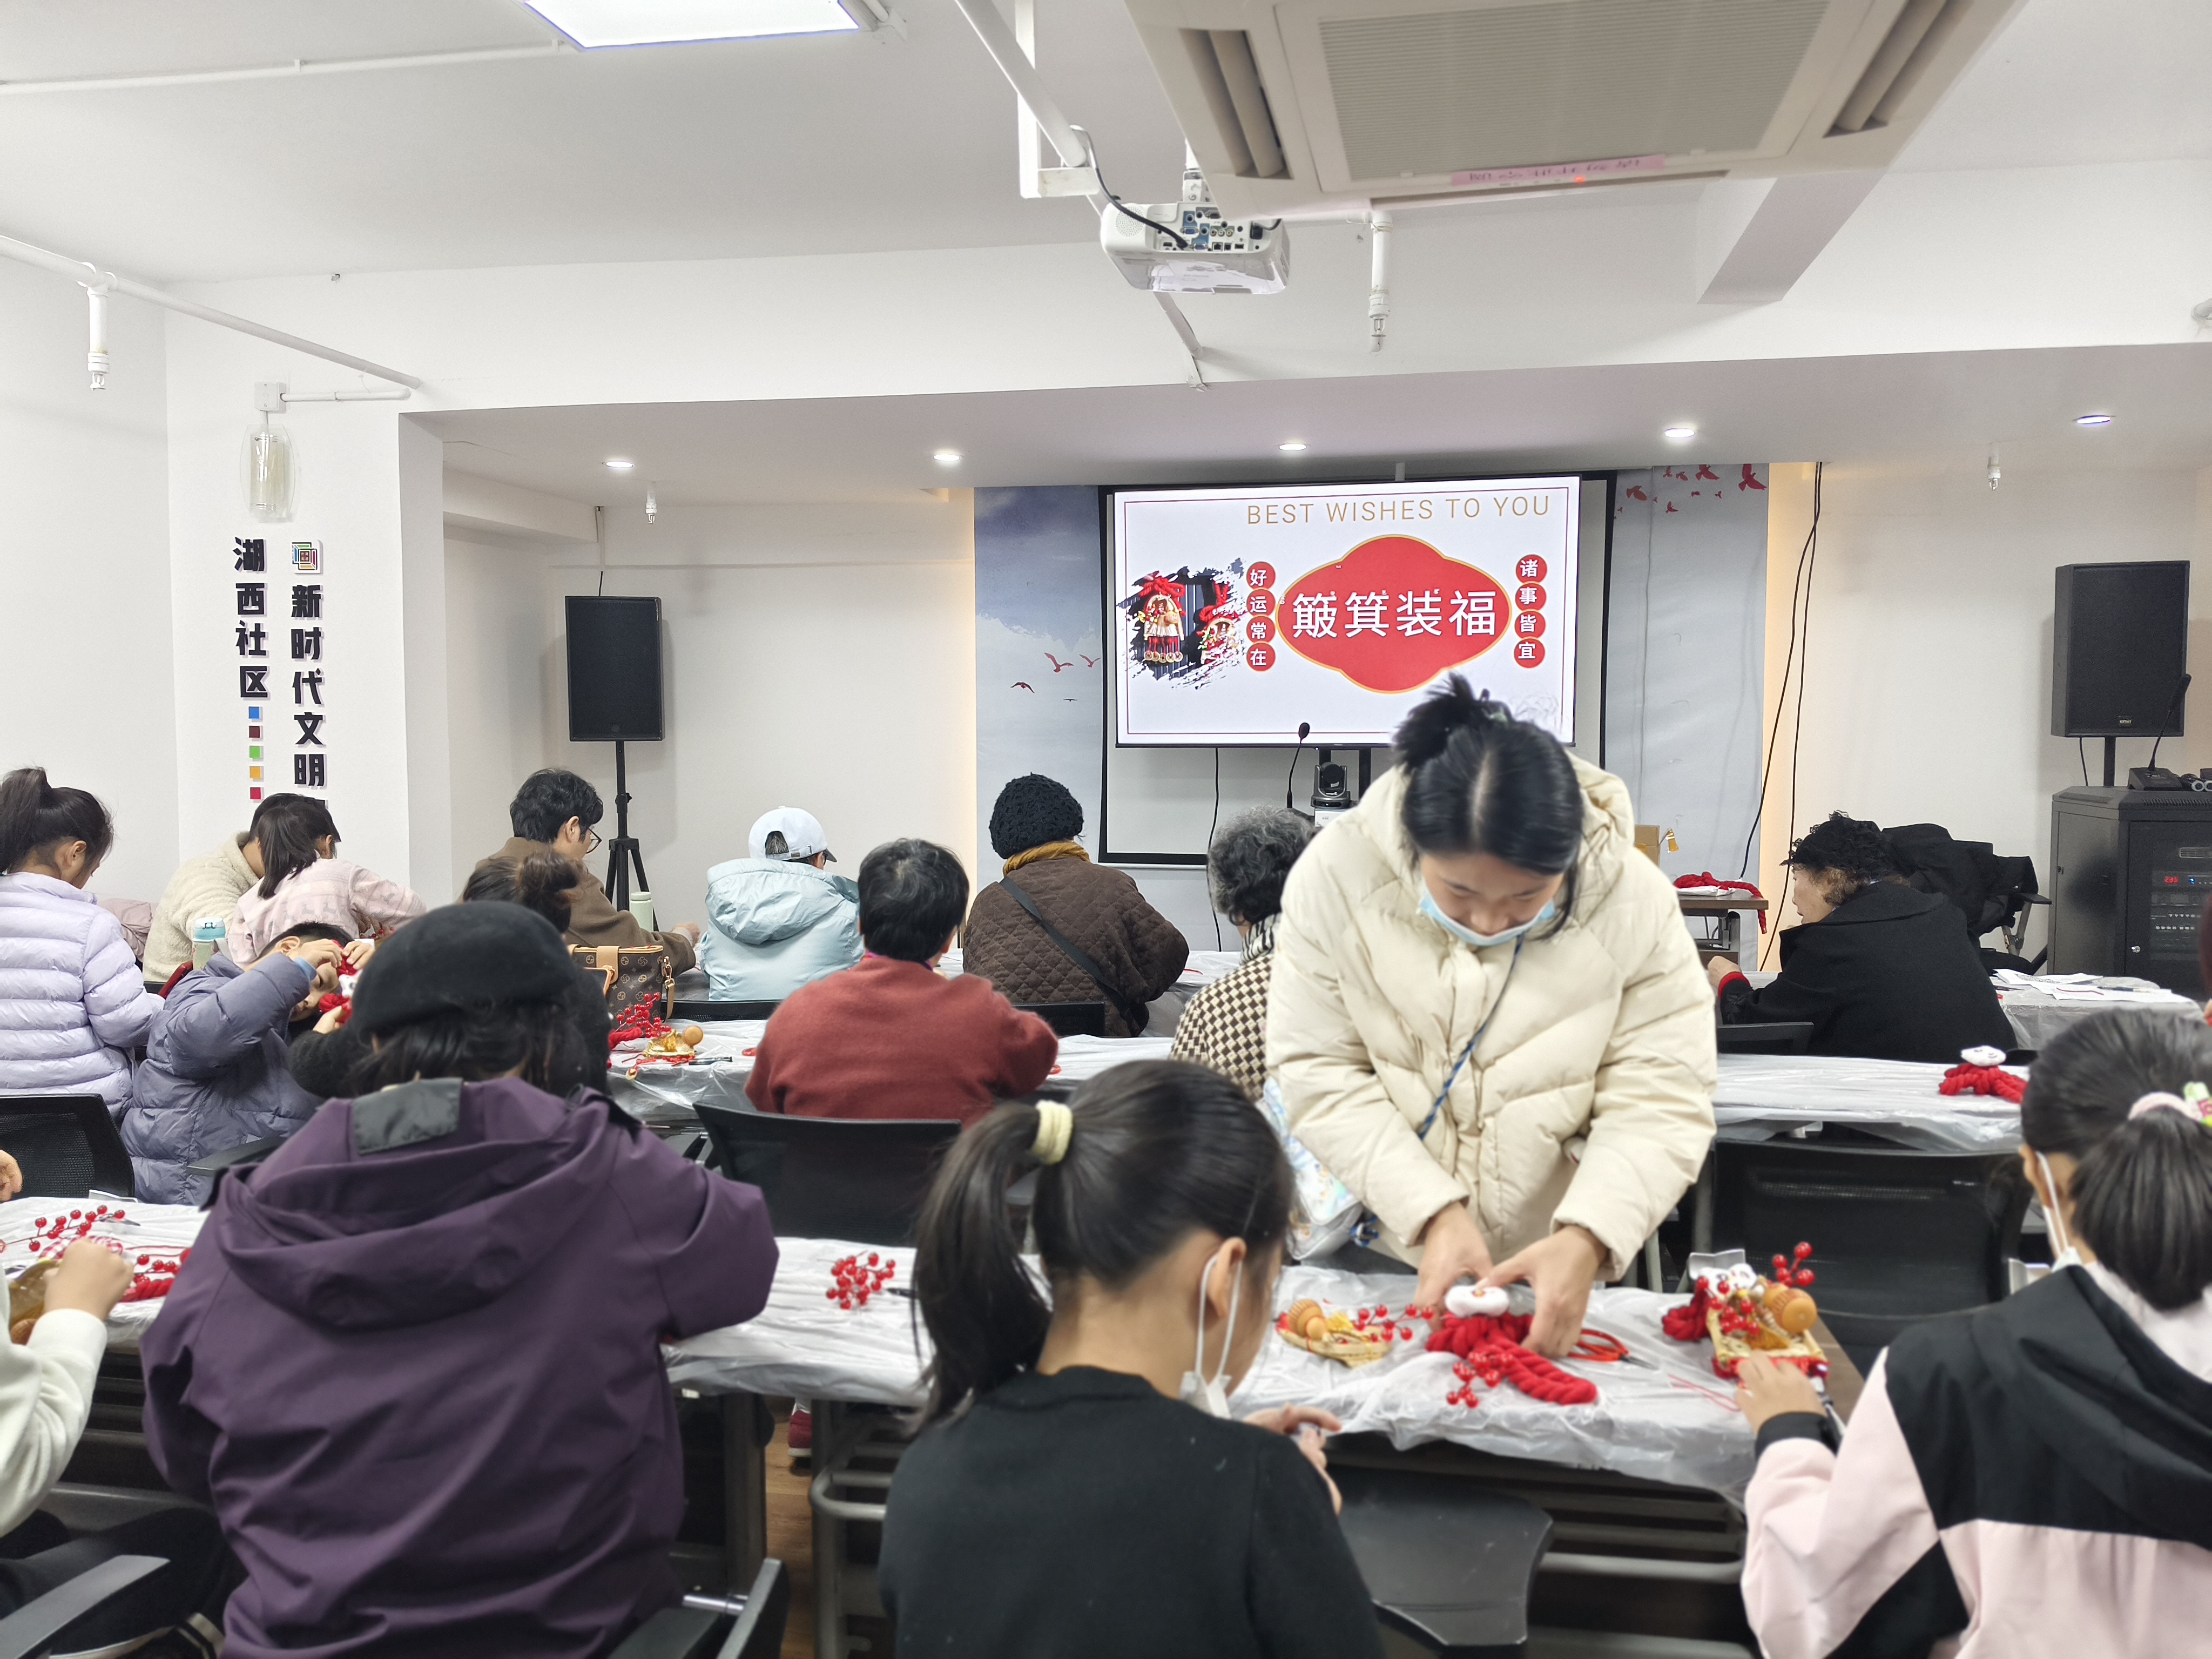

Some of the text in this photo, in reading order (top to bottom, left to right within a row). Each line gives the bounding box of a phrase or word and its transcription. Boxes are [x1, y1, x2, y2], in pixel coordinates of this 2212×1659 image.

[1248, 495, 1549, 524] BEST WISHES TO YOU
[233, 536, 269, 698] 湖西社区
[1250, 569, 1267, 666] 好运常在
[1292, 590, 1496, 638] 簸箕装福
[1518, 558, 1539, 659] 诸事皆宜
[291, 584, 327, 807] 新时代文明
